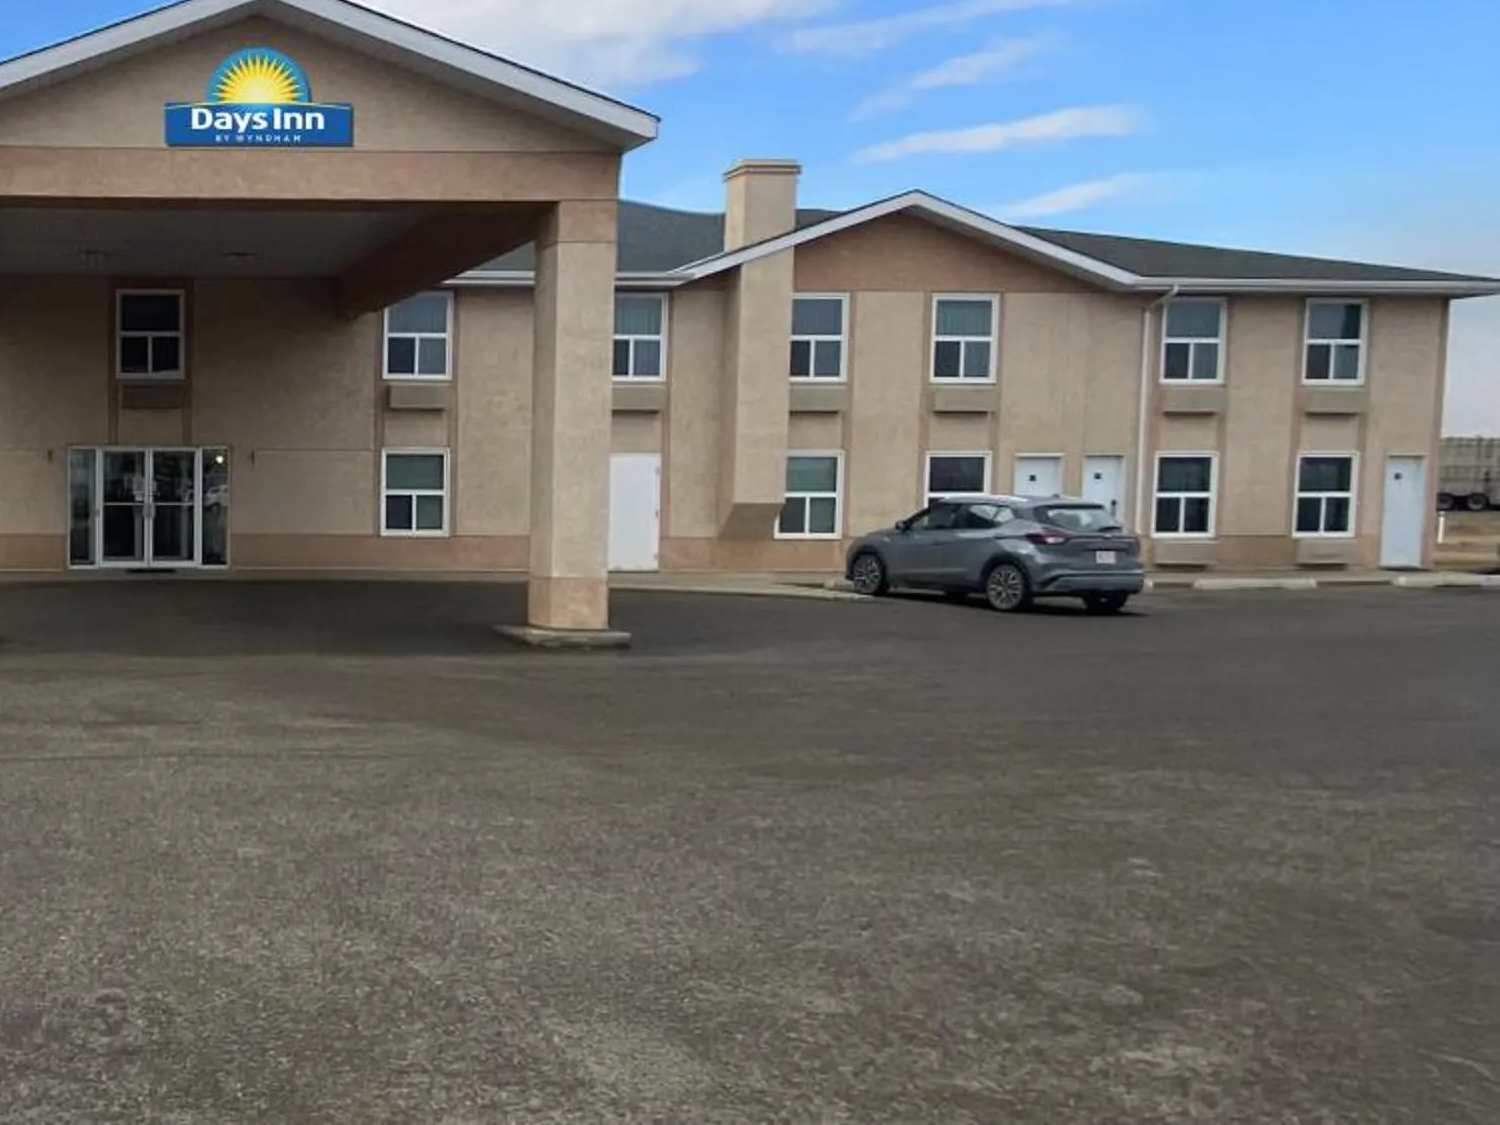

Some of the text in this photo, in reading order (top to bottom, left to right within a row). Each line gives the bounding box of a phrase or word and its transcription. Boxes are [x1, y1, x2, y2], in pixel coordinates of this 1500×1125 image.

[191, 108, 325, 132] Days Inn
[215, 134, 302, 142] BY WYNDHAM
